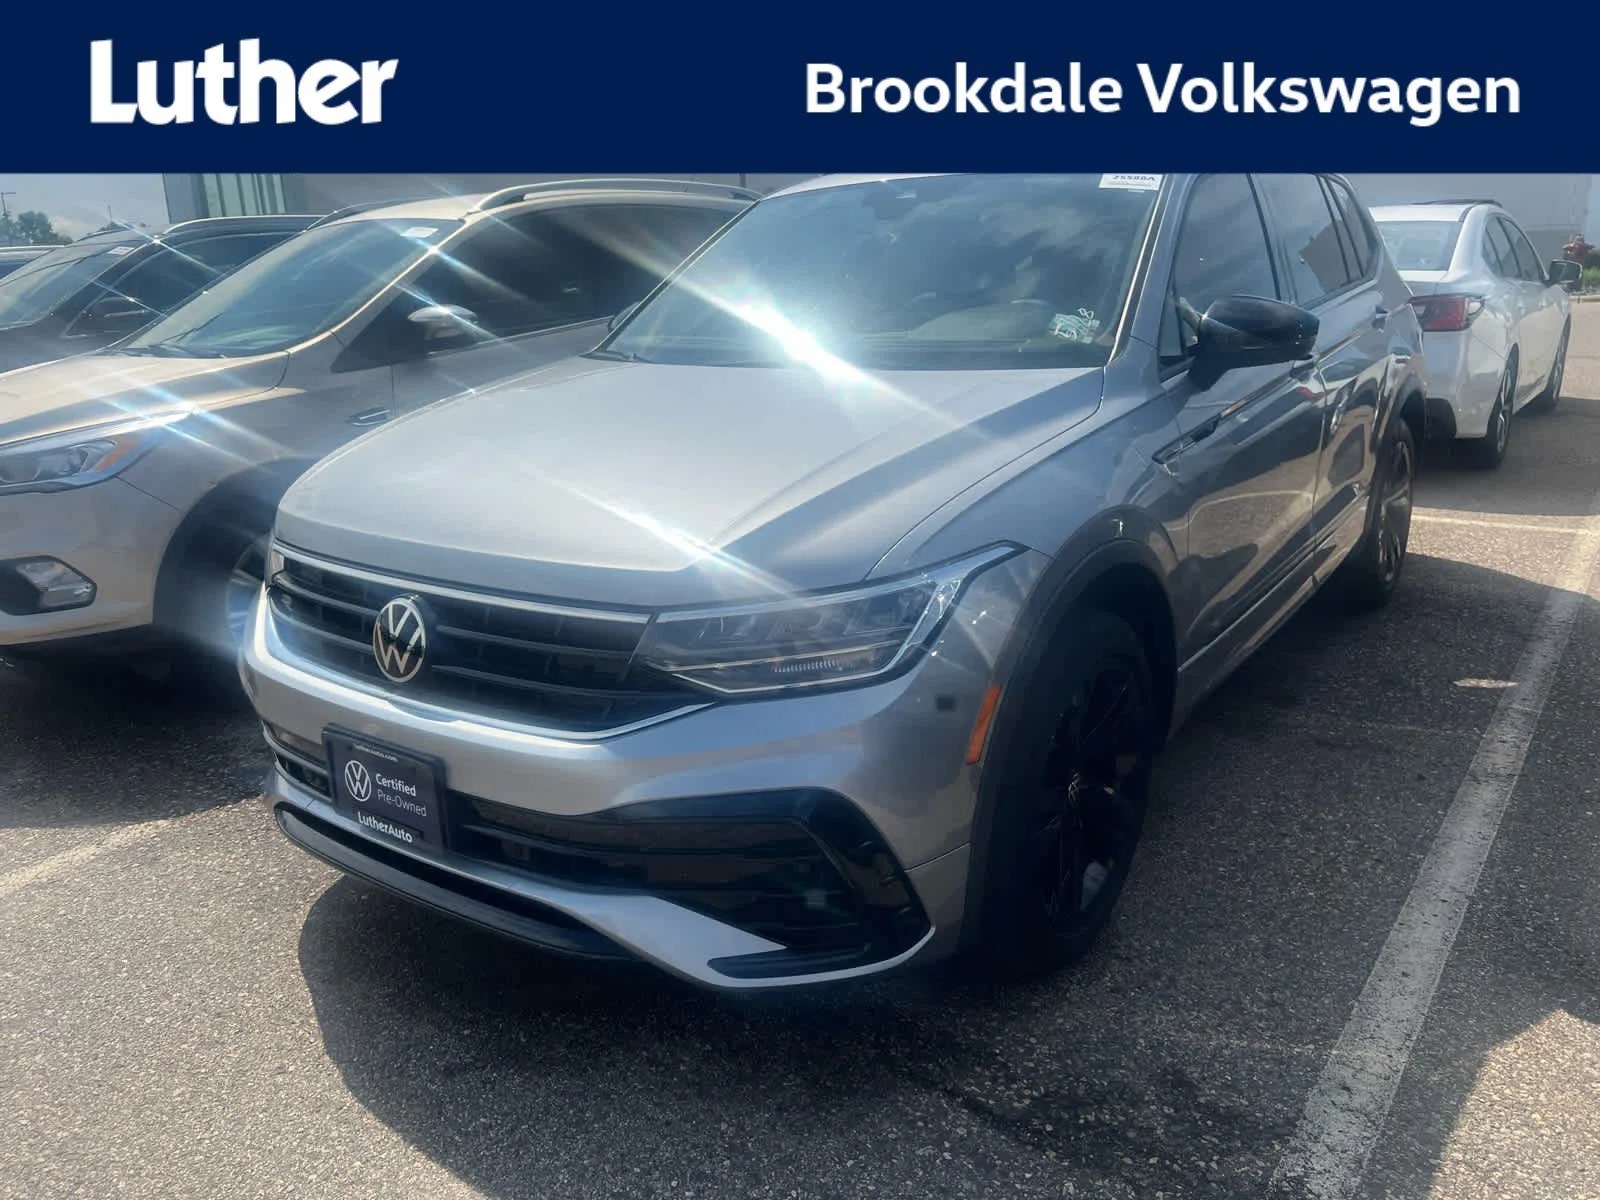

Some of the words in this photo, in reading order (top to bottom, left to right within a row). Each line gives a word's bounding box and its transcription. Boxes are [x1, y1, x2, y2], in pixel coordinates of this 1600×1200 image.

[375, 773, 417, 797] Certified
[377, 789, 427, 817] Pre-Owned
[357, 811, 413, 843] LutherAuto
